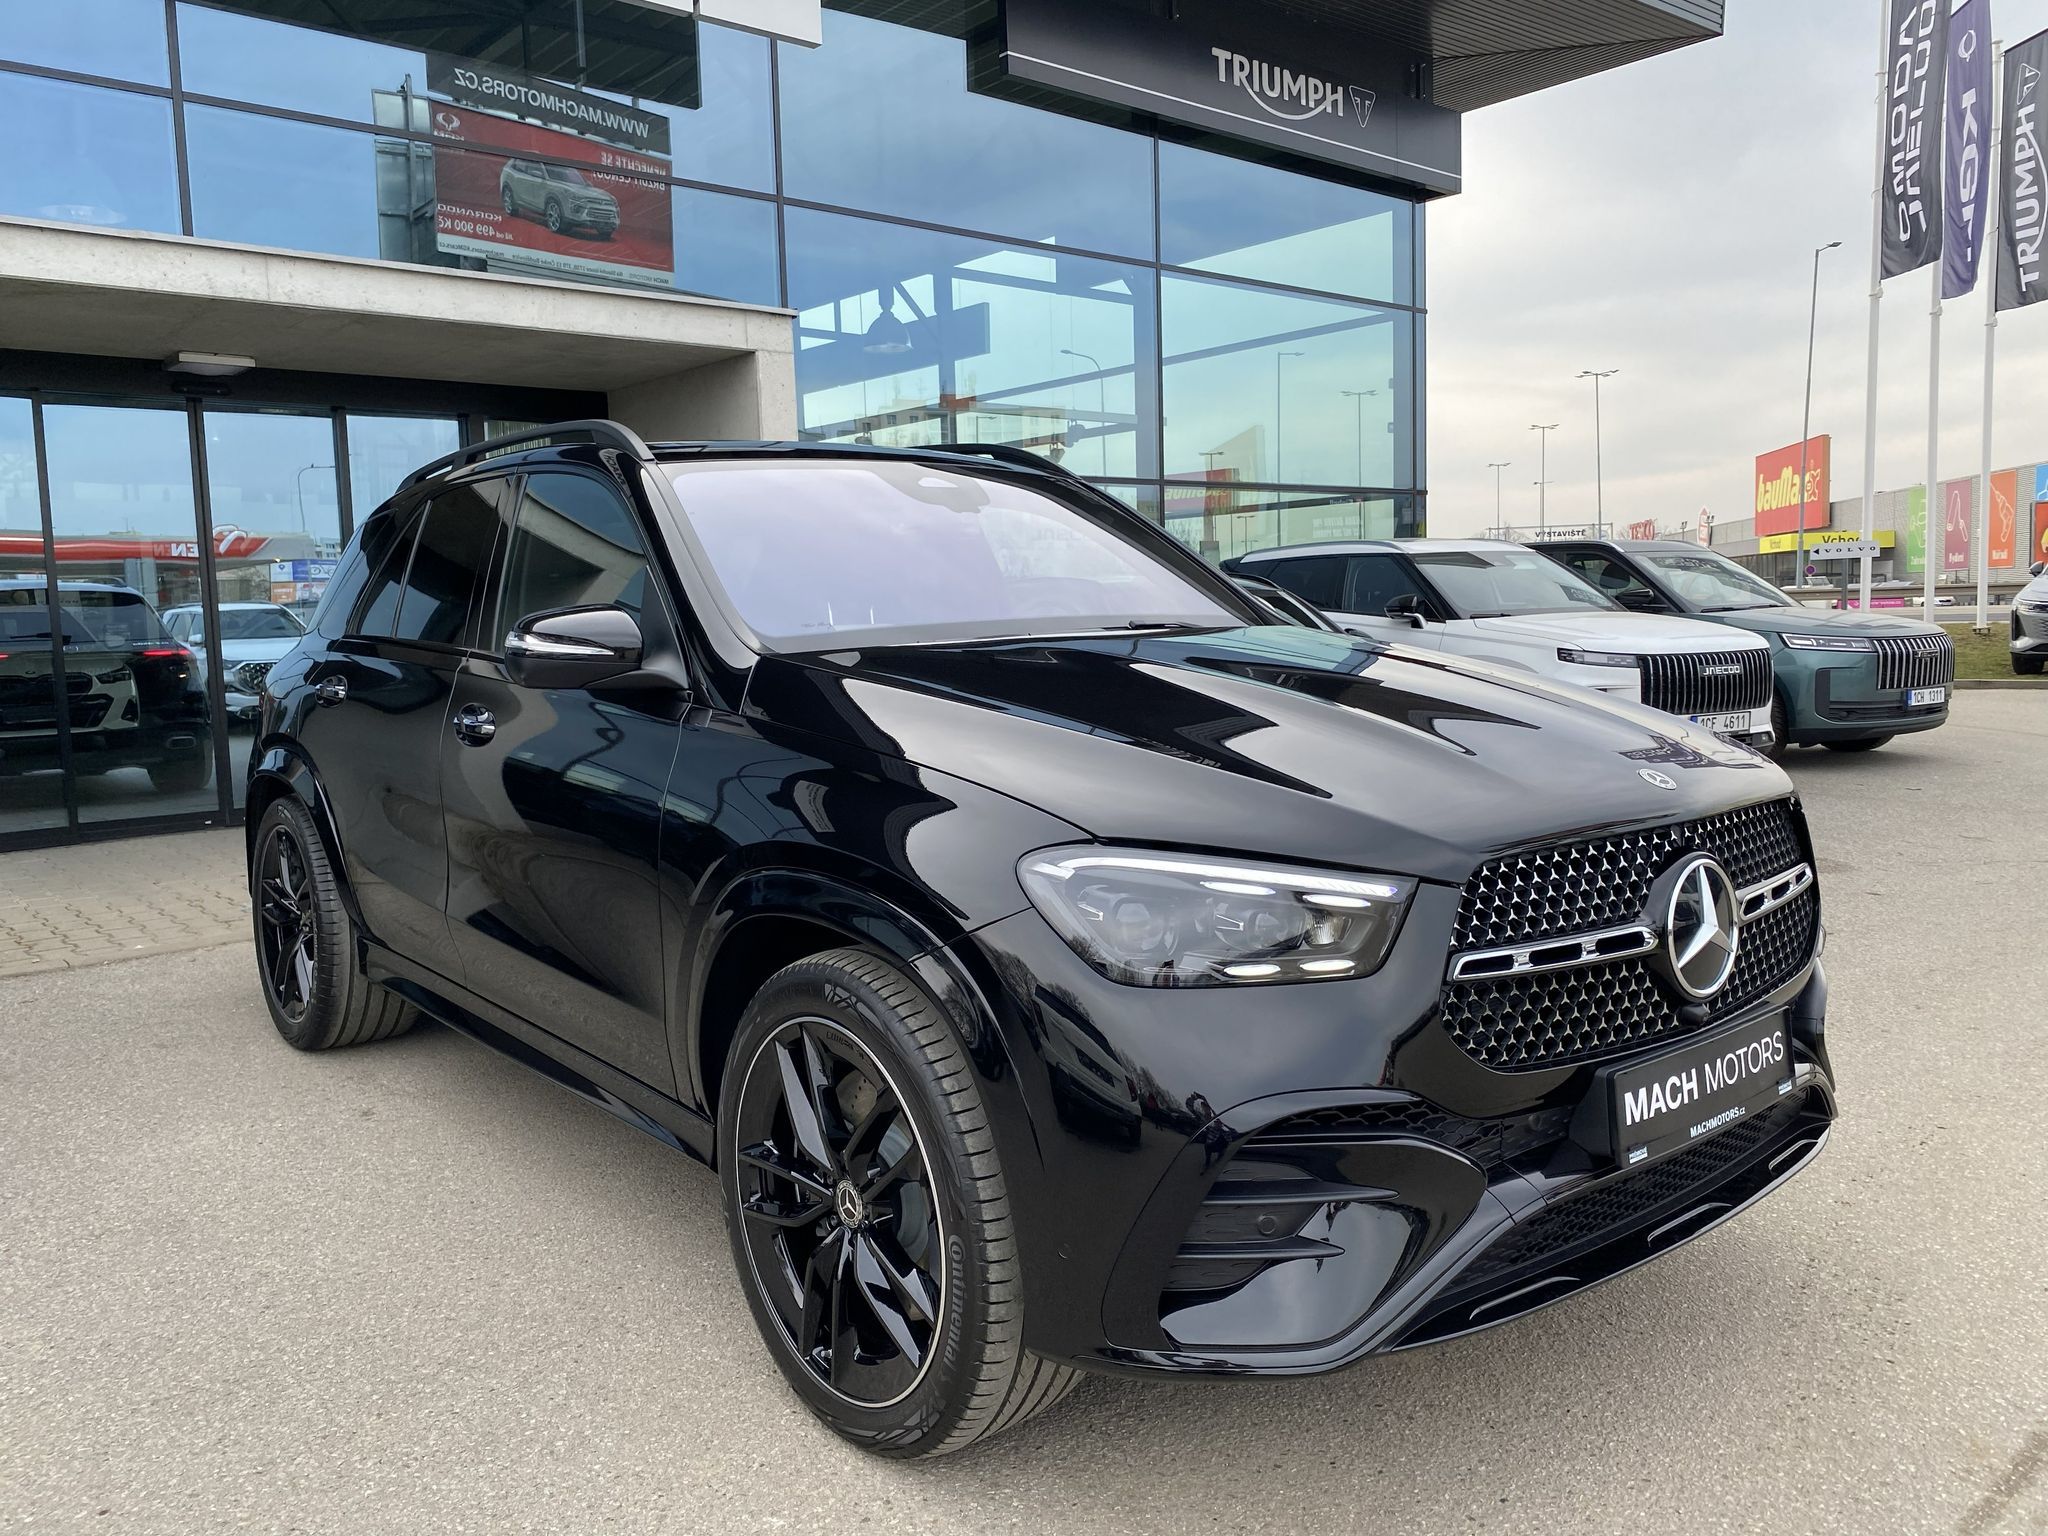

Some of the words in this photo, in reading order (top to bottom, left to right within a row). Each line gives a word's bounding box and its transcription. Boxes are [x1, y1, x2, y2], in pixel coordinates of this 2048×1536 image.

[1211, 46, 1344, 121] TRIUMPH
[2014, 102, 2048, 293] TRIUMPH
[1822, 535, 1863, 543] Vcho
[1724, 715, 1745, 729] 4611
[1929, 689, 1943, 702] 1311
[1624, 1068, 1699, 1126] MACH
[1704, 1031, 1784, 1095] MOTORS
[943, 1234, 968, 1371] Continental
